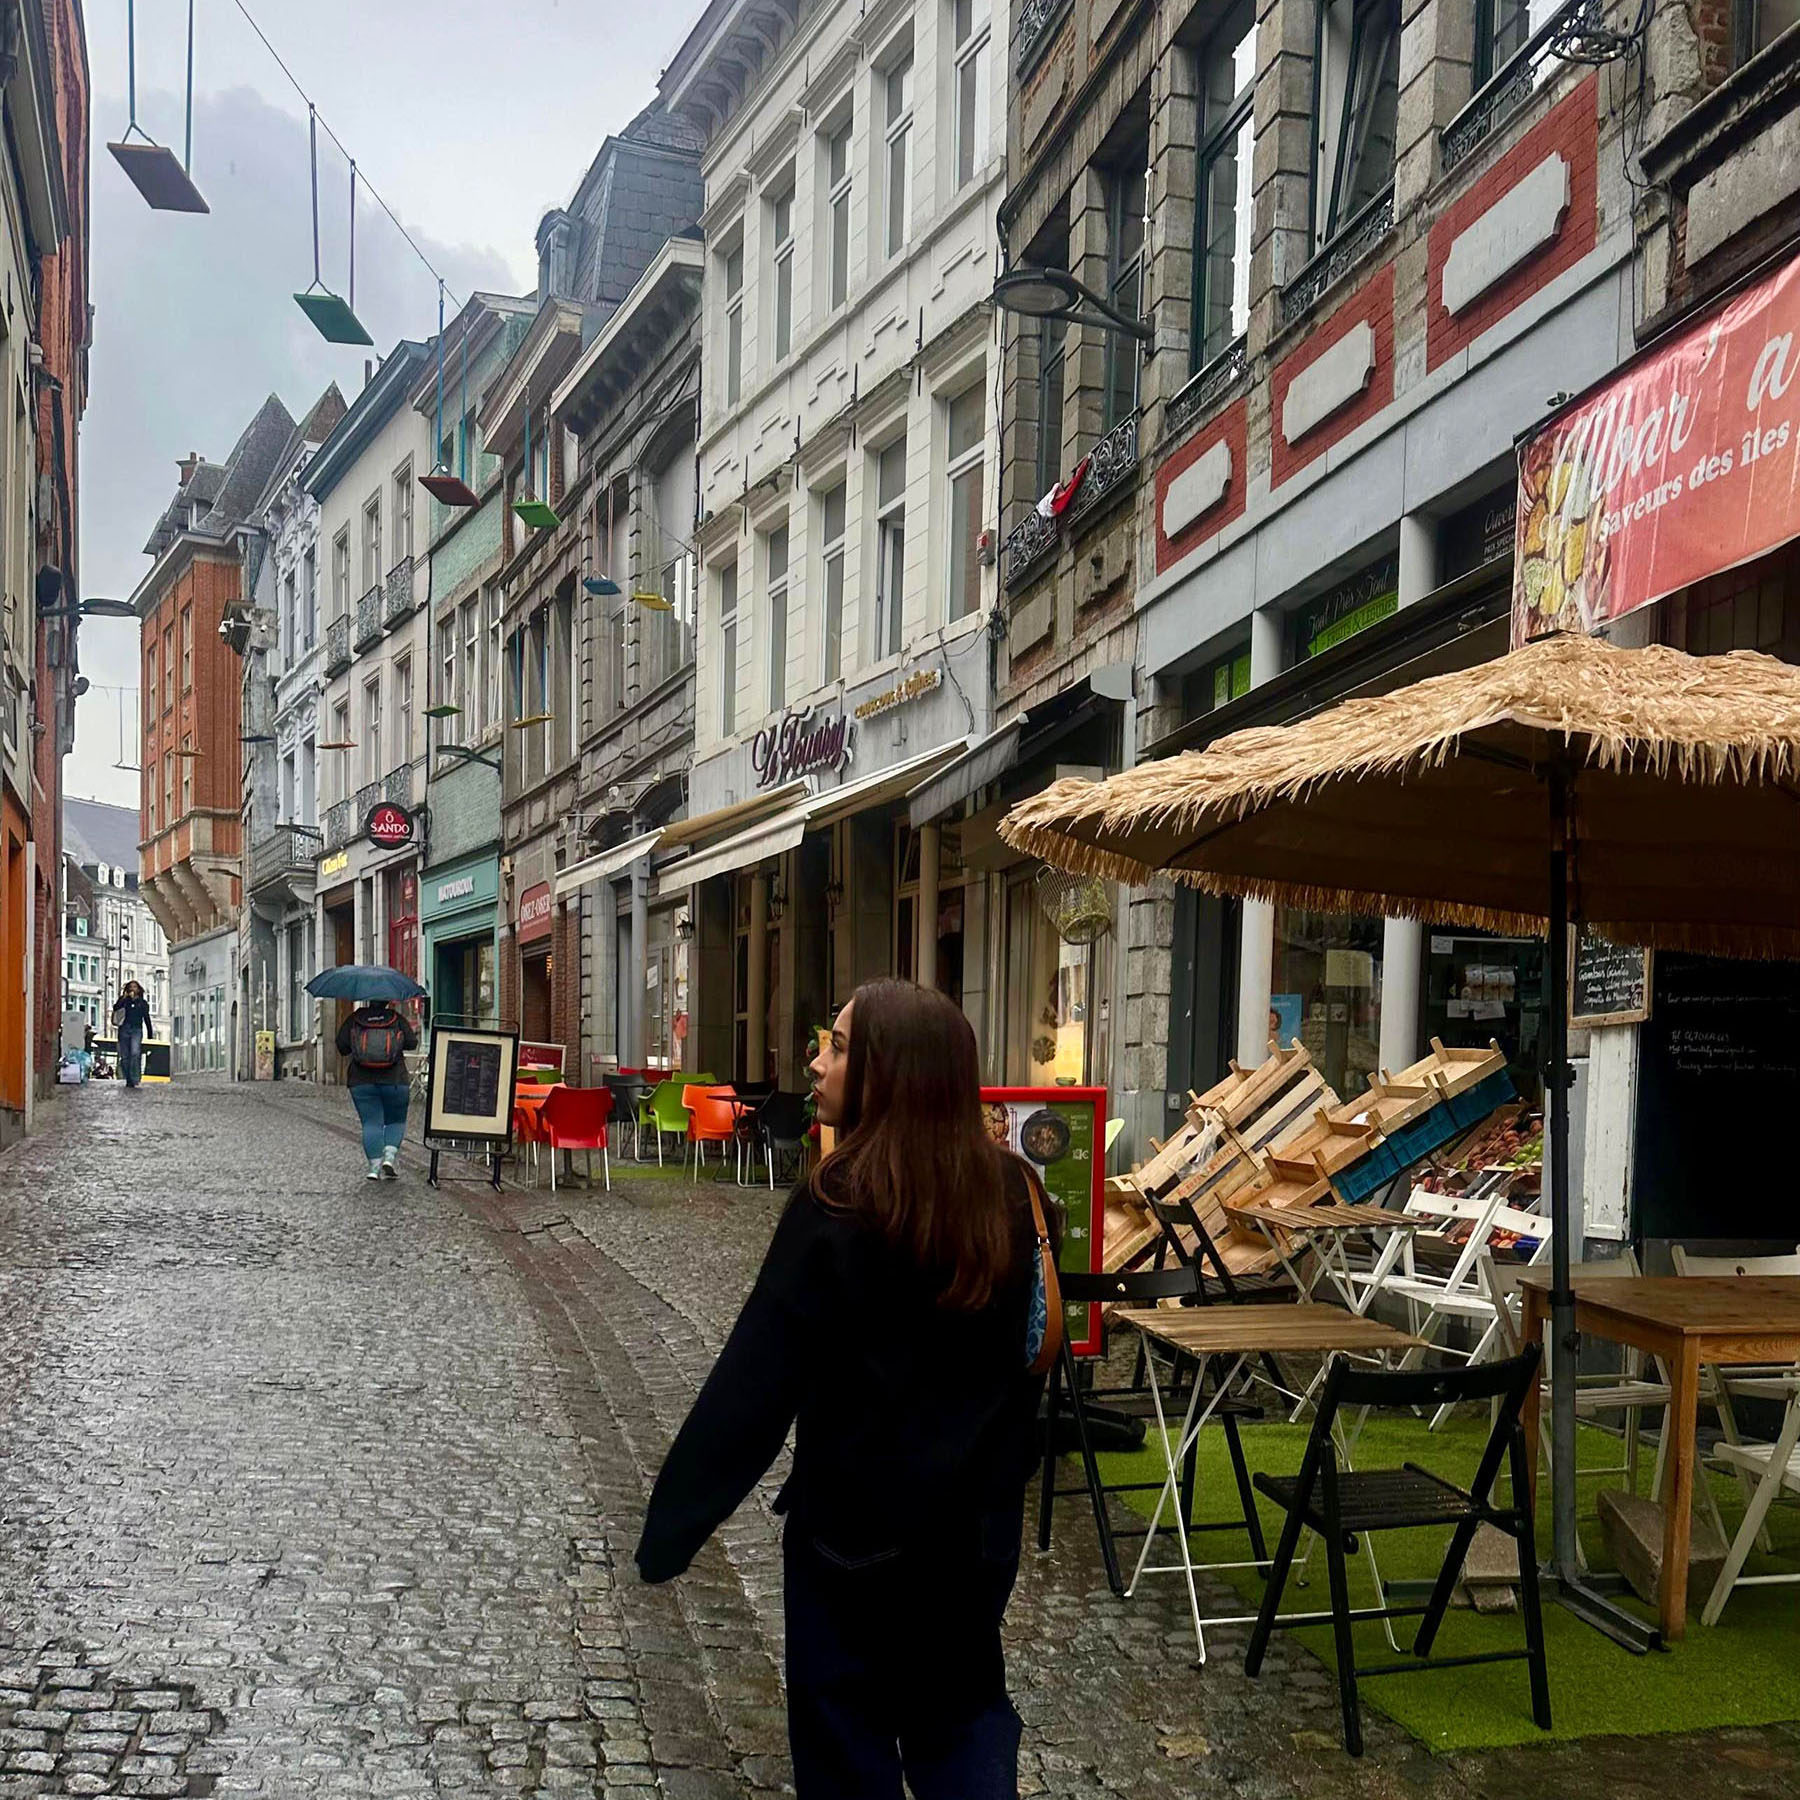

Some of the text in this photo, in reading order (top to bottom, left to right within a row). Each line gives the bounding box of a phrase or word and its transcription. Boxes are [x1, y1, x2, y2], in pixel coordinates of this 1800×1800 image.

[1689, 450, 1733, 490] des
[1740, 420, 1790, 467] îles
[385, 810, 395, 823] Ô
[370, 822, 410, 834] SANDO
